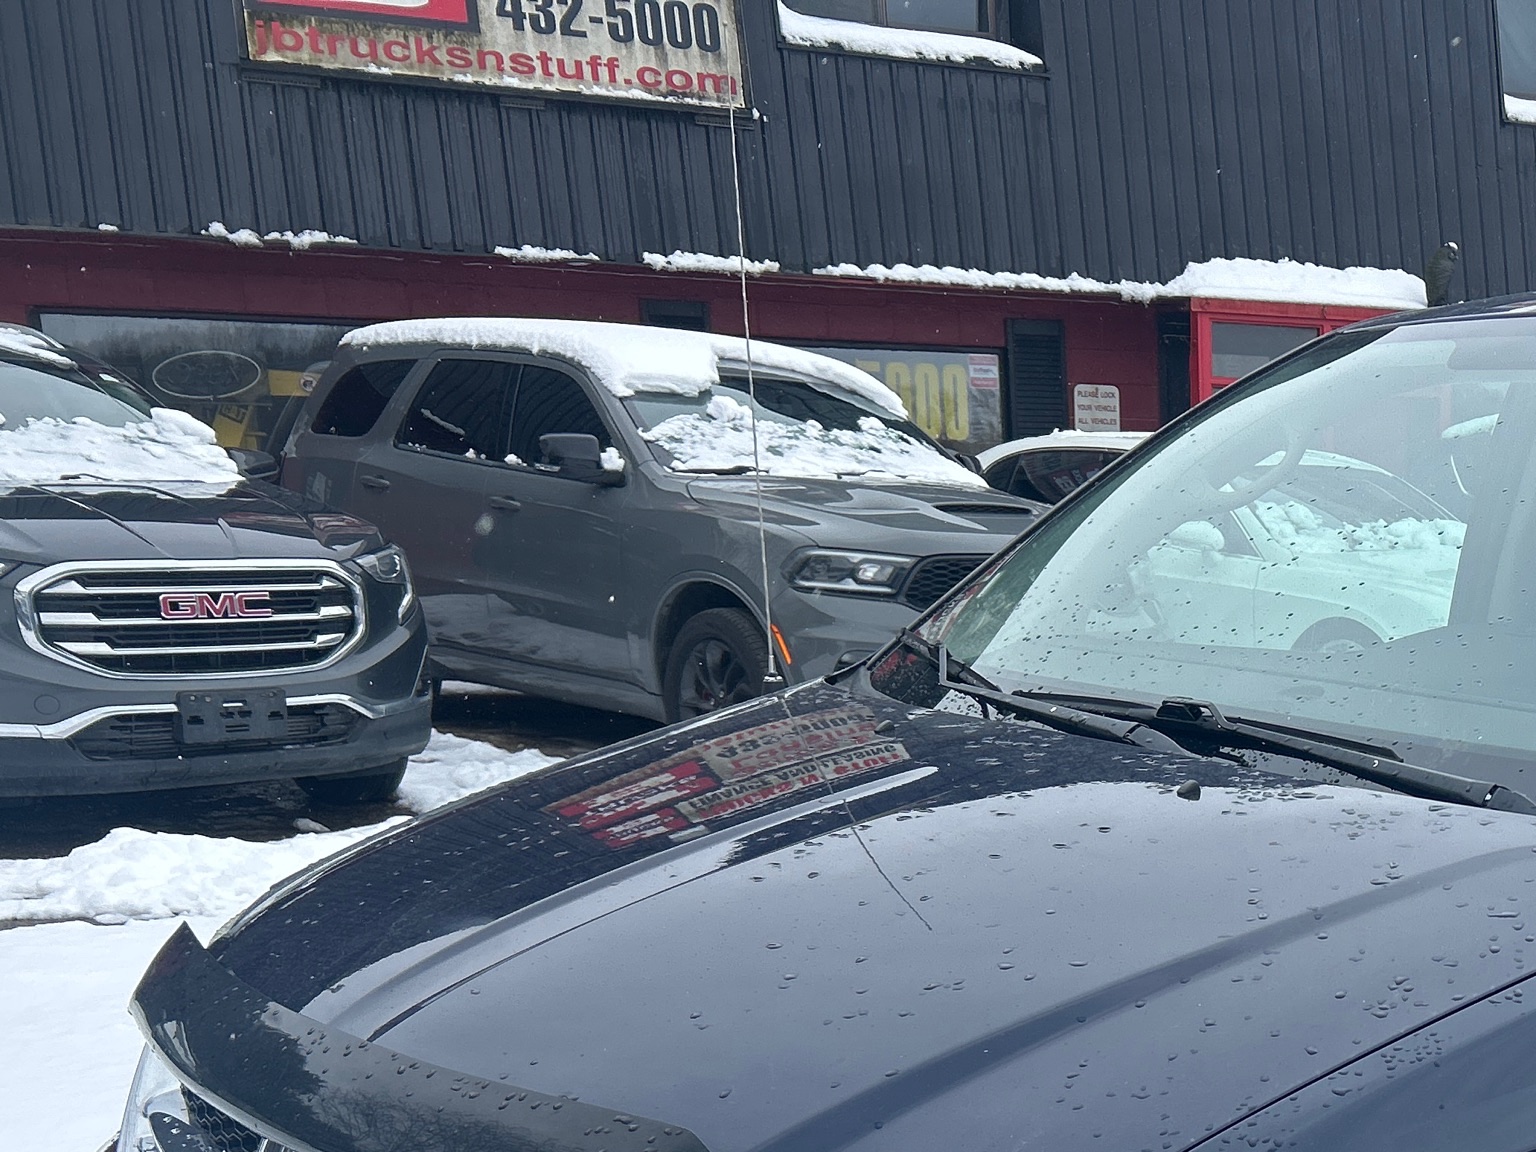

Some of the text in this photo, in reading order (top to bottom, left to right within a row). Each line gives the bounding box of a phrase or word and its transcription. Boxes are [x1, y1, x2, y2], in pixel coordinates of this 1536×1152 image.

[496, 0, 721, 53] 432-5000
[255, 19, 737, 96] jbtrucksnstuff.com
[1077, 390, 1116, 399] PLEASE LOCK
[159, 591, 273, 619] GMC
